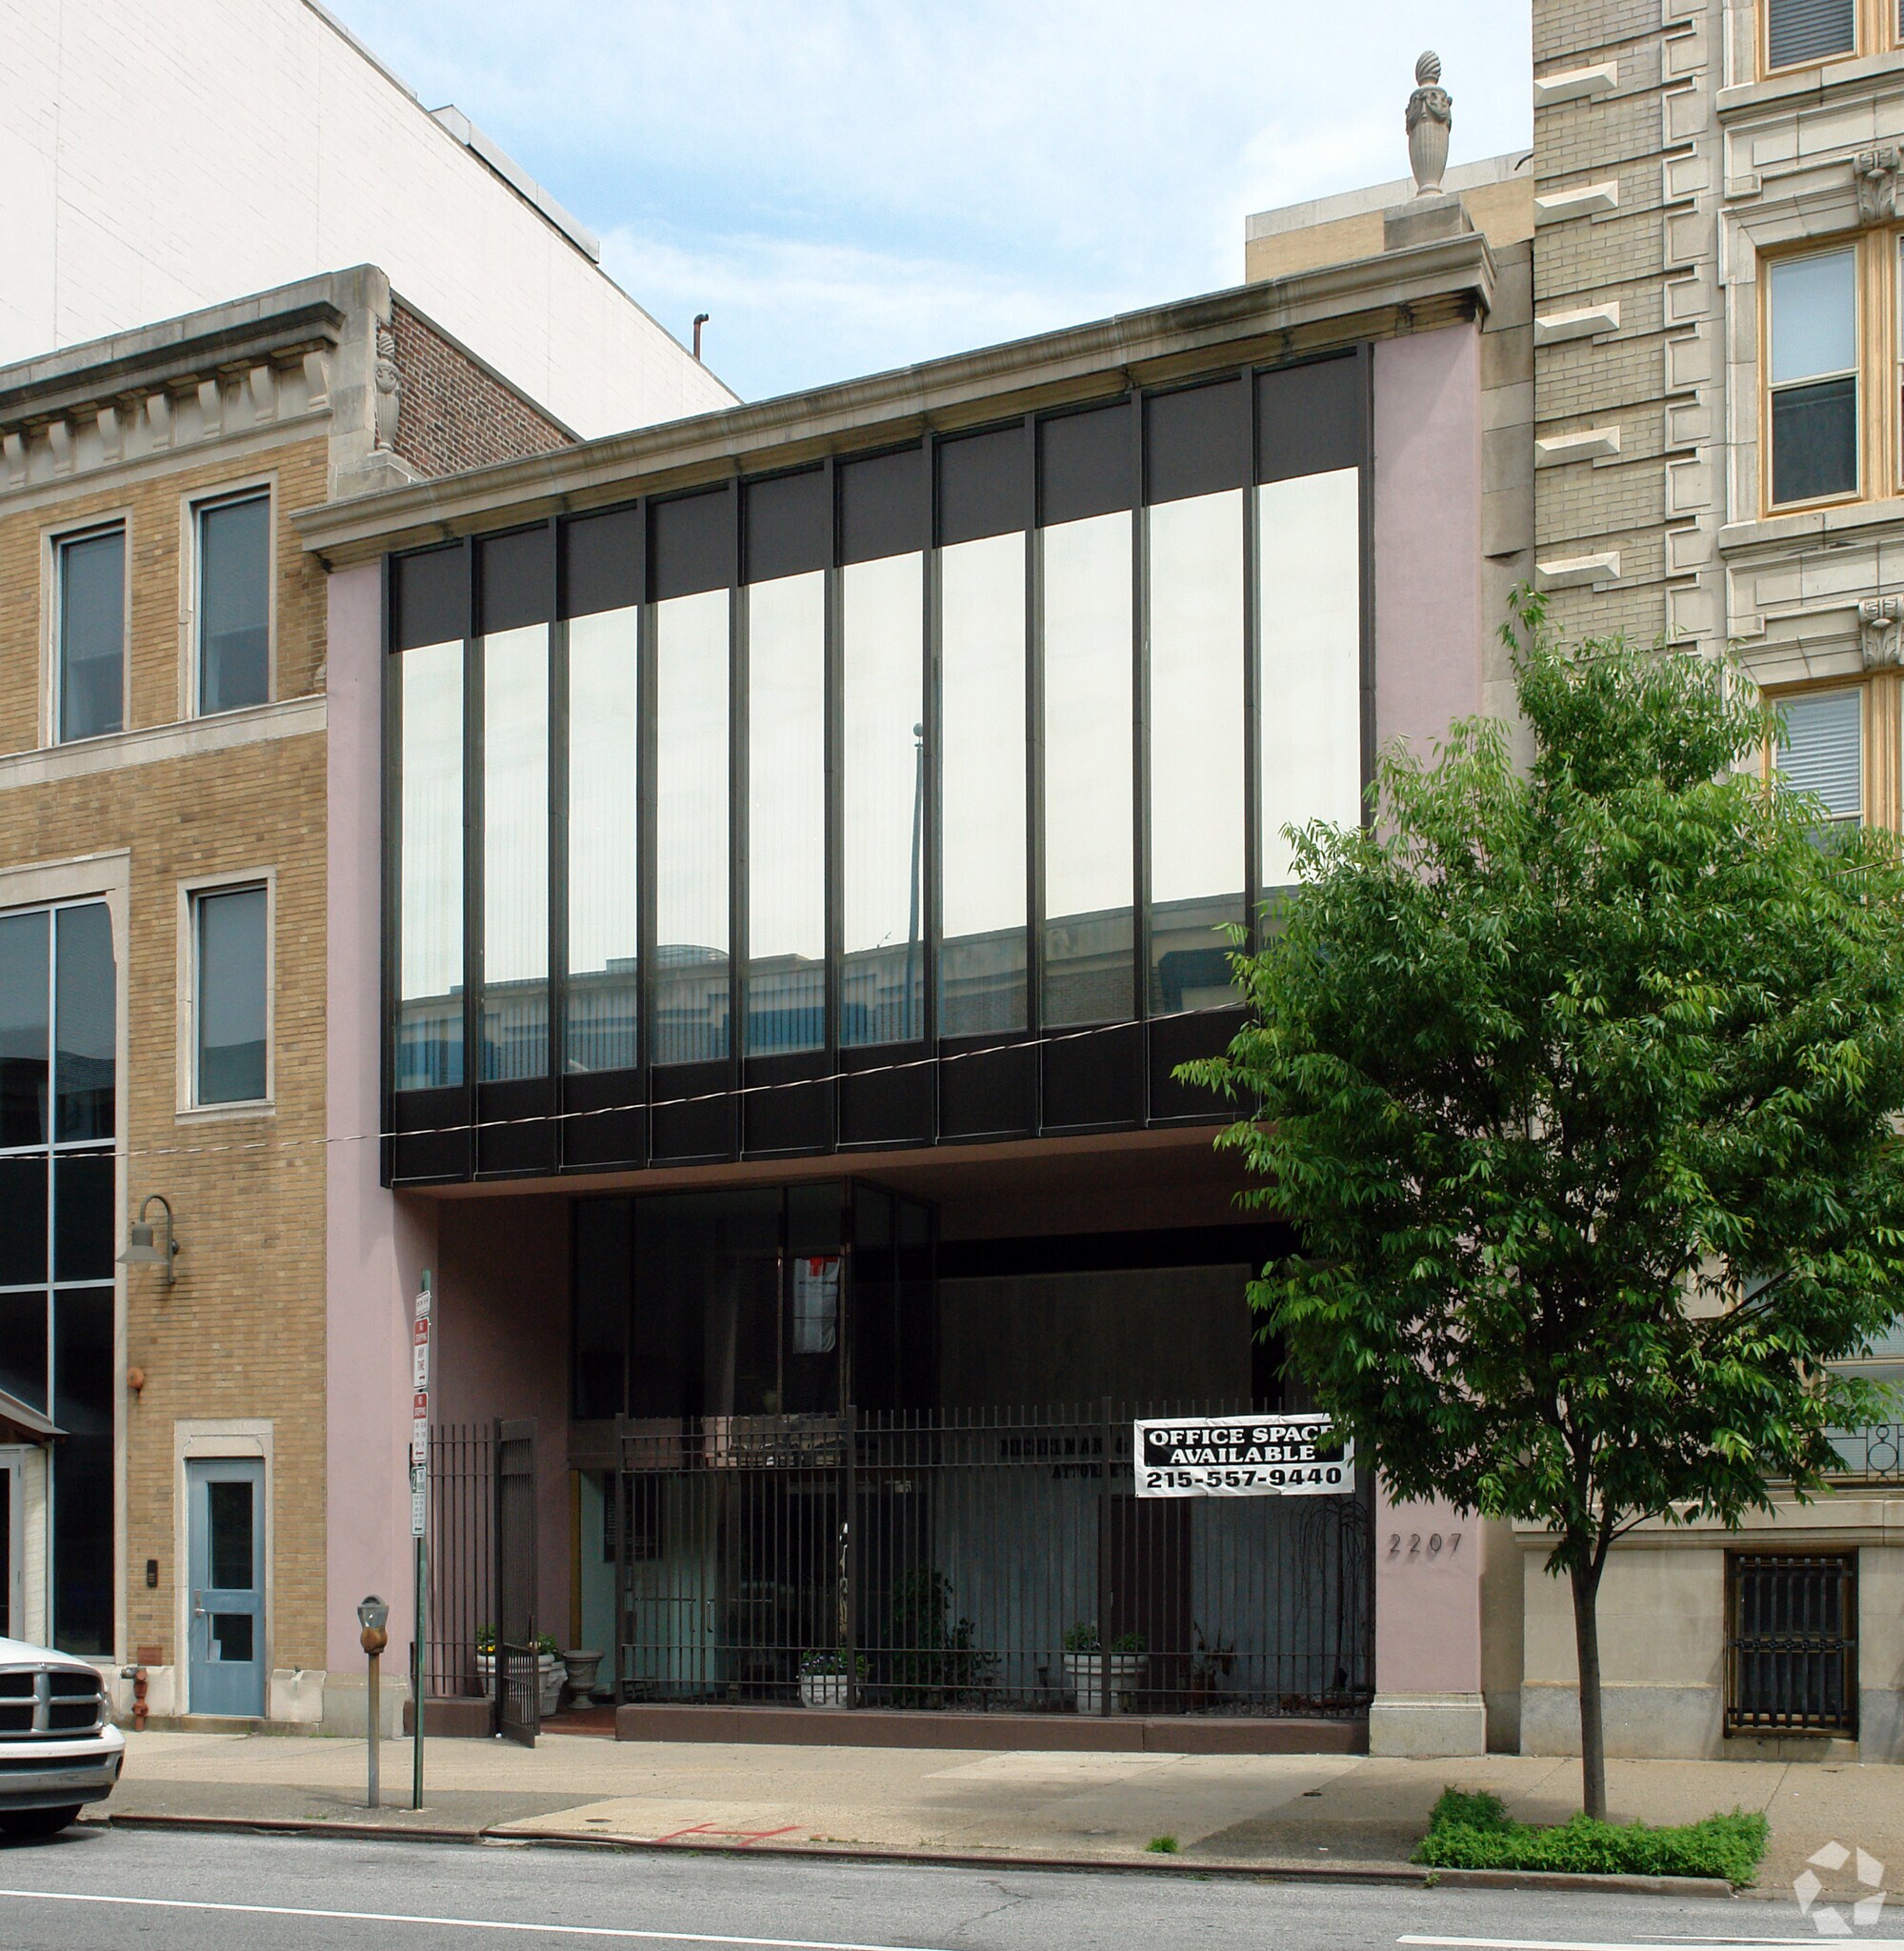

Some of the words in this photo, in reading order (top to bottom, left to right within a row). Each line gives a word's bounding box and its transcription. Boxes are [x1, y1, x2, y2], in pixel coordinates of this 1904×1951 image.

[1149, 1428, 1245, 1446] OFFICE
[1170, 1444, 1316, 1464] AVAILABLE
[1147, 1467, 1342, 1488] 215-557-9440
[1390, 1533, 1462, 1554] 2207
